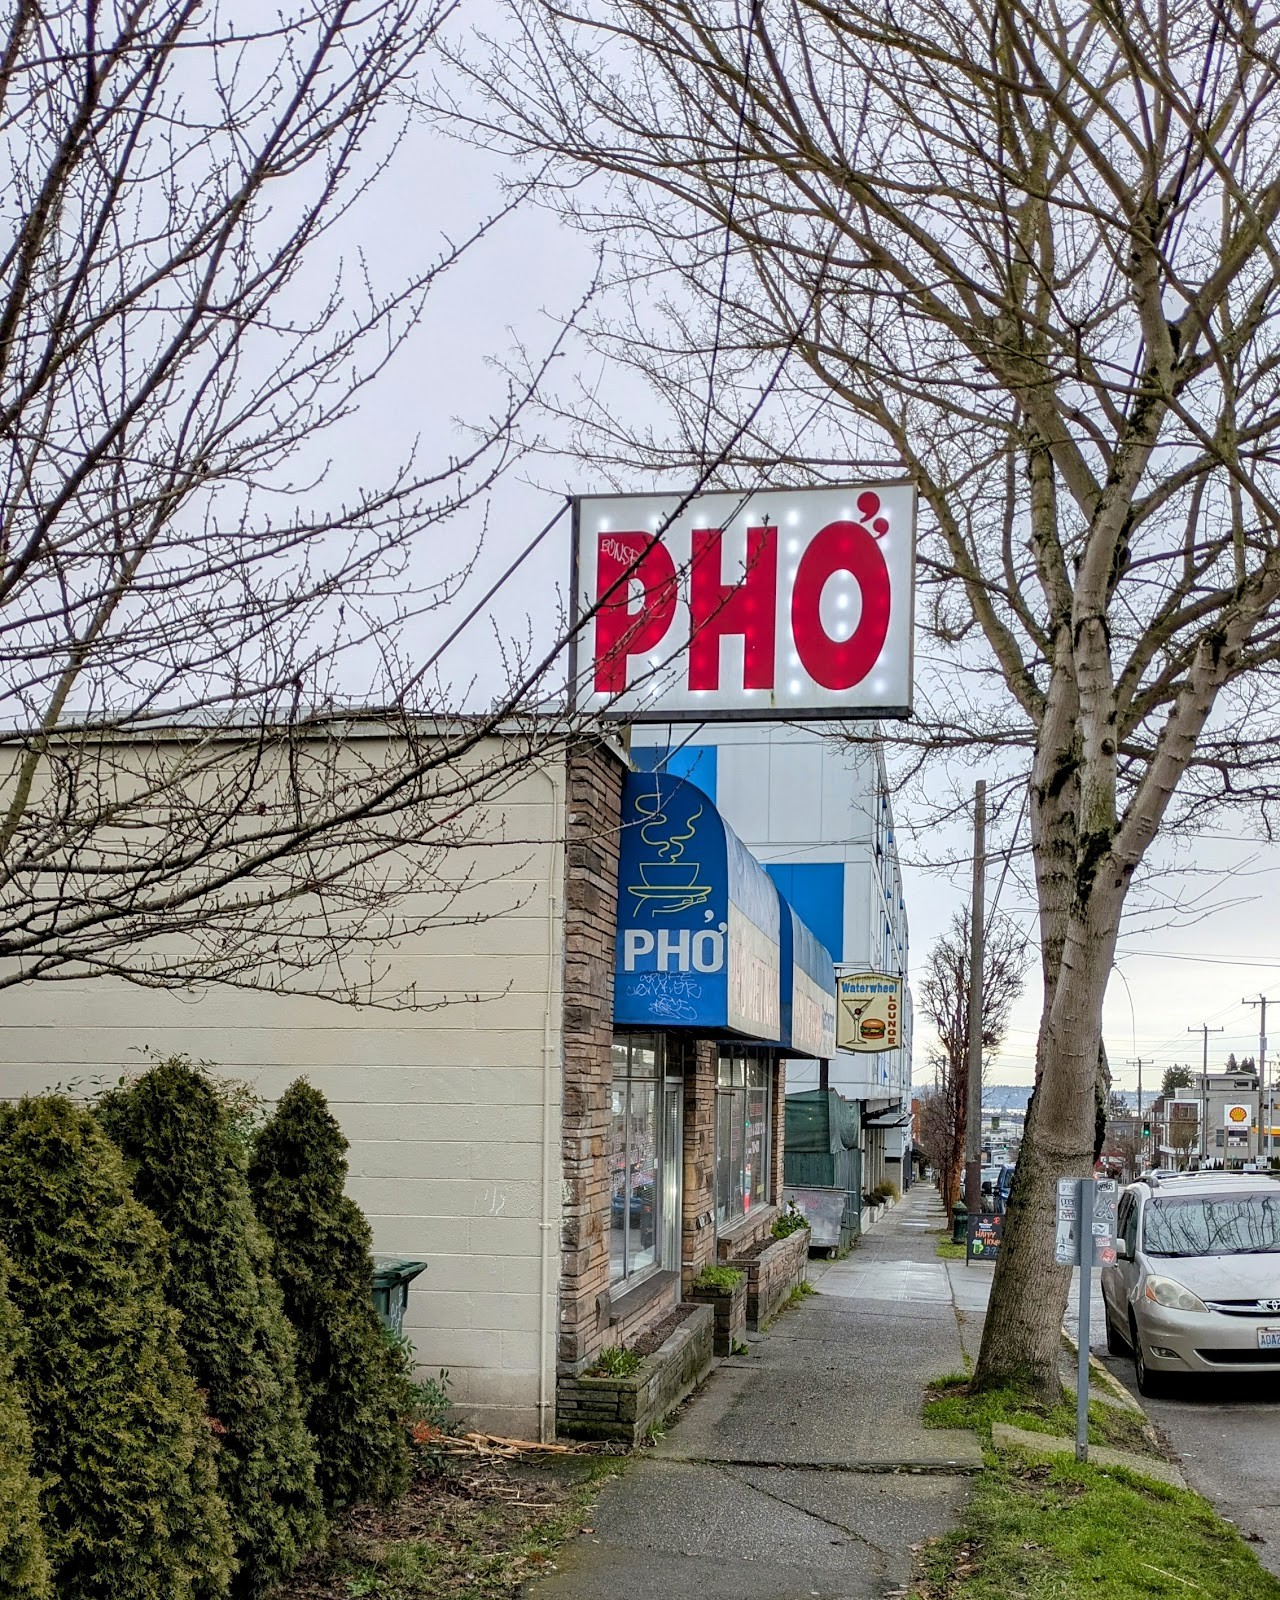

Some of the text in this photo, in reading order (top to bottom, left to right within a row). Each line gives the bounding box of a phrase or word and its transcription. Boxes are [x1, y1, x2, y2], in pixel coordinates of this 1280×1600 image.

[841, 981, 898, 993] Waterwheel
[887, 995, 898, 1044] LOUNGE
[975, 1231, 997, 1239] HAPPY
